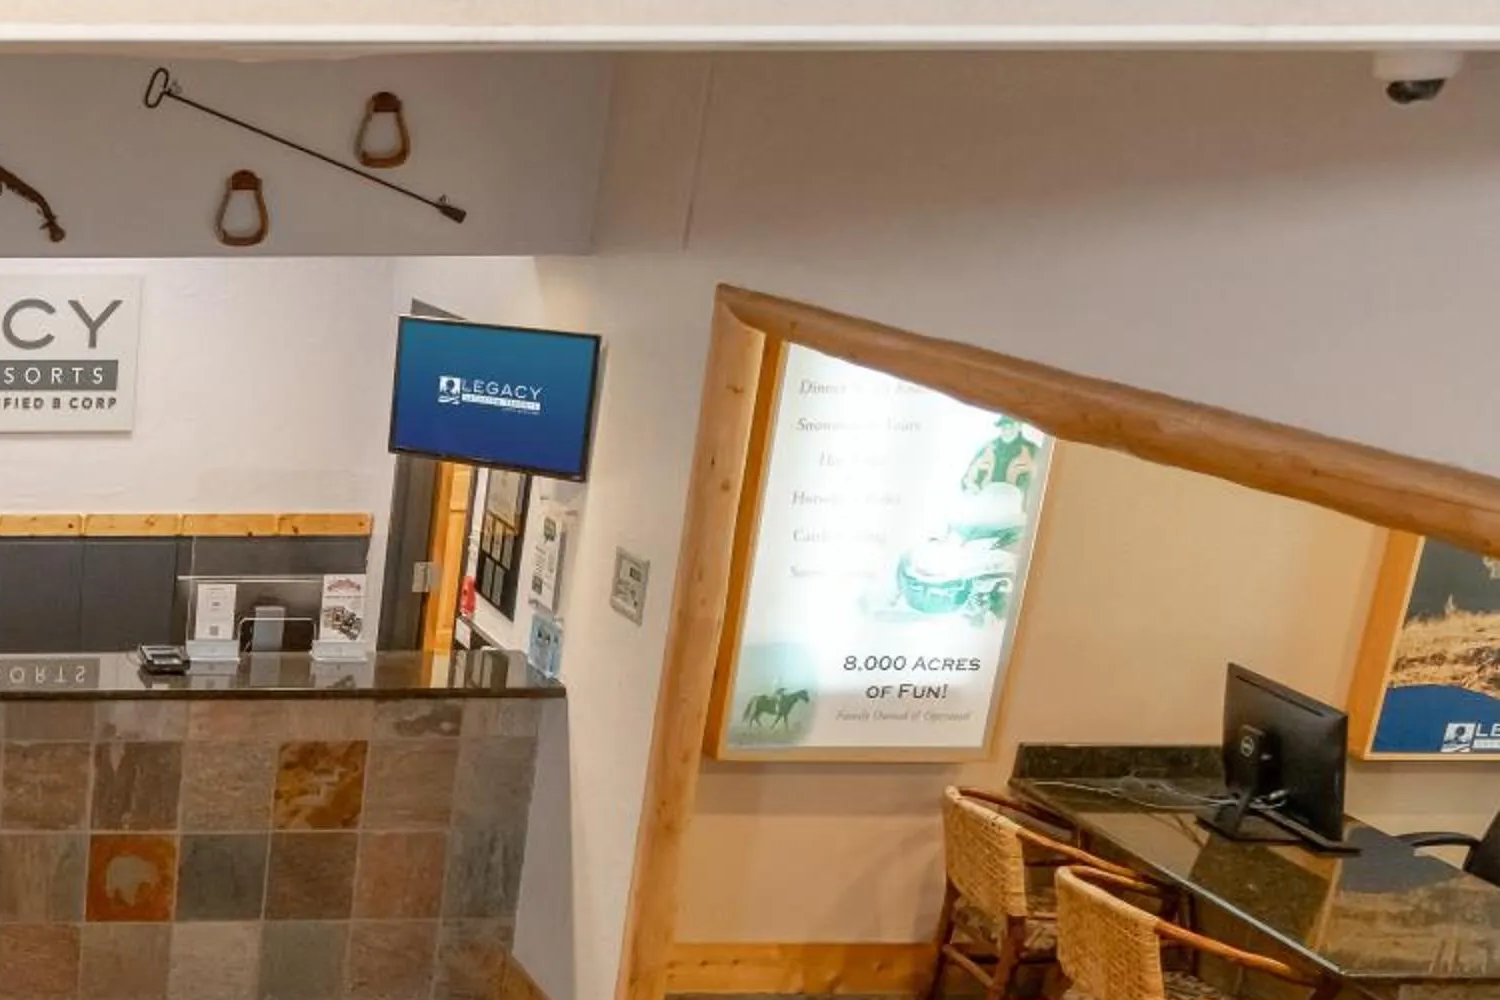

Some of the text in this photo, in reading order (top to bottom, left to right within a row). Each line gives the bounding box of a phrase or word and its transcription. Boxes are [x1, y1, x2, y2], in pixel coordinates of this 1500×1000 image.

[461, 378, 542, 401] LEGACY
[52, 397, 61, 409] B
[69, 397, 117, 410] CORP
